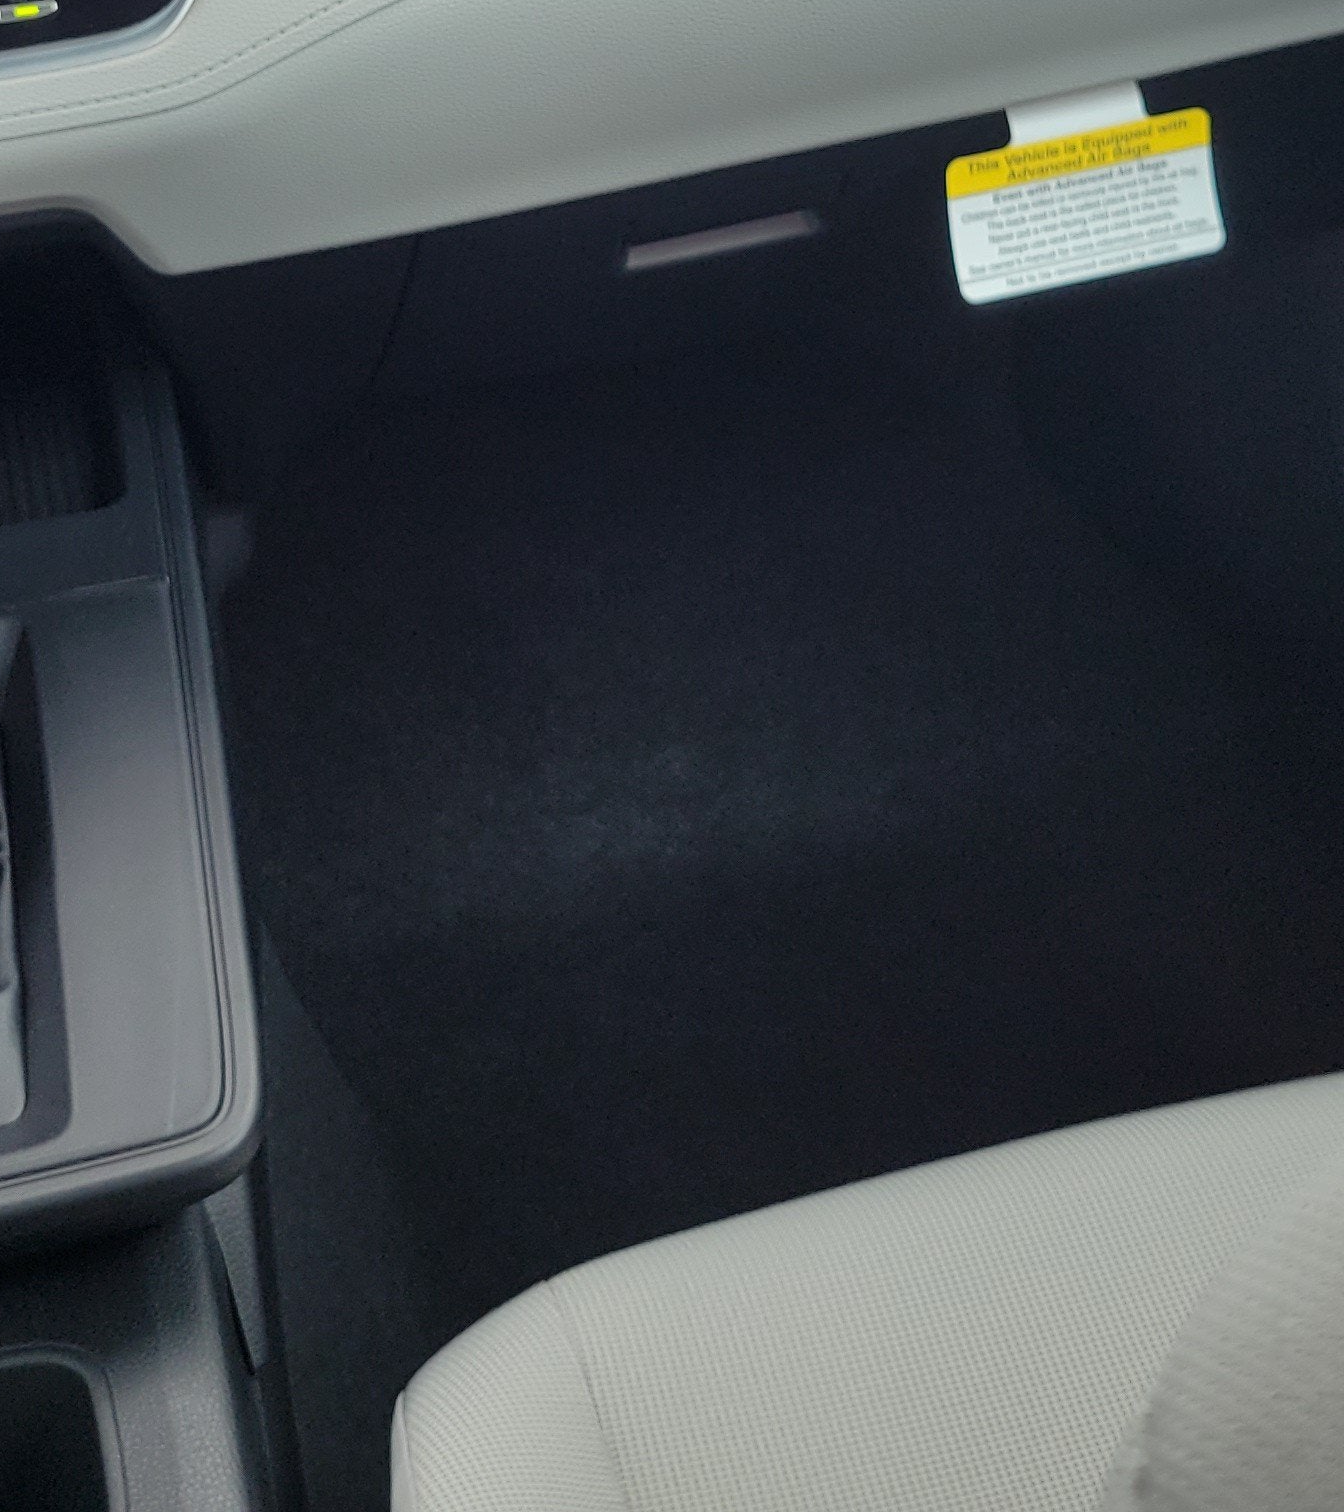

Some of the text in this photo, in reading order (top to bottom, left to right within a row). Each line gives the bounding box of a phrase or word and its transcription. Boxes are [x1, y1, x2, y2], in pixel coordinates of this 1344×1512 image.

[1004, 146, 1060, 166] Vehicle
[1063, 139, 1077, 154] is
[1082, 125, 1152, 151] Equipped
[1157, 118, 1188, 134] with
[1008, 155, 1083, 180] Advanced
[1087, 149, 1106, 164] Air
